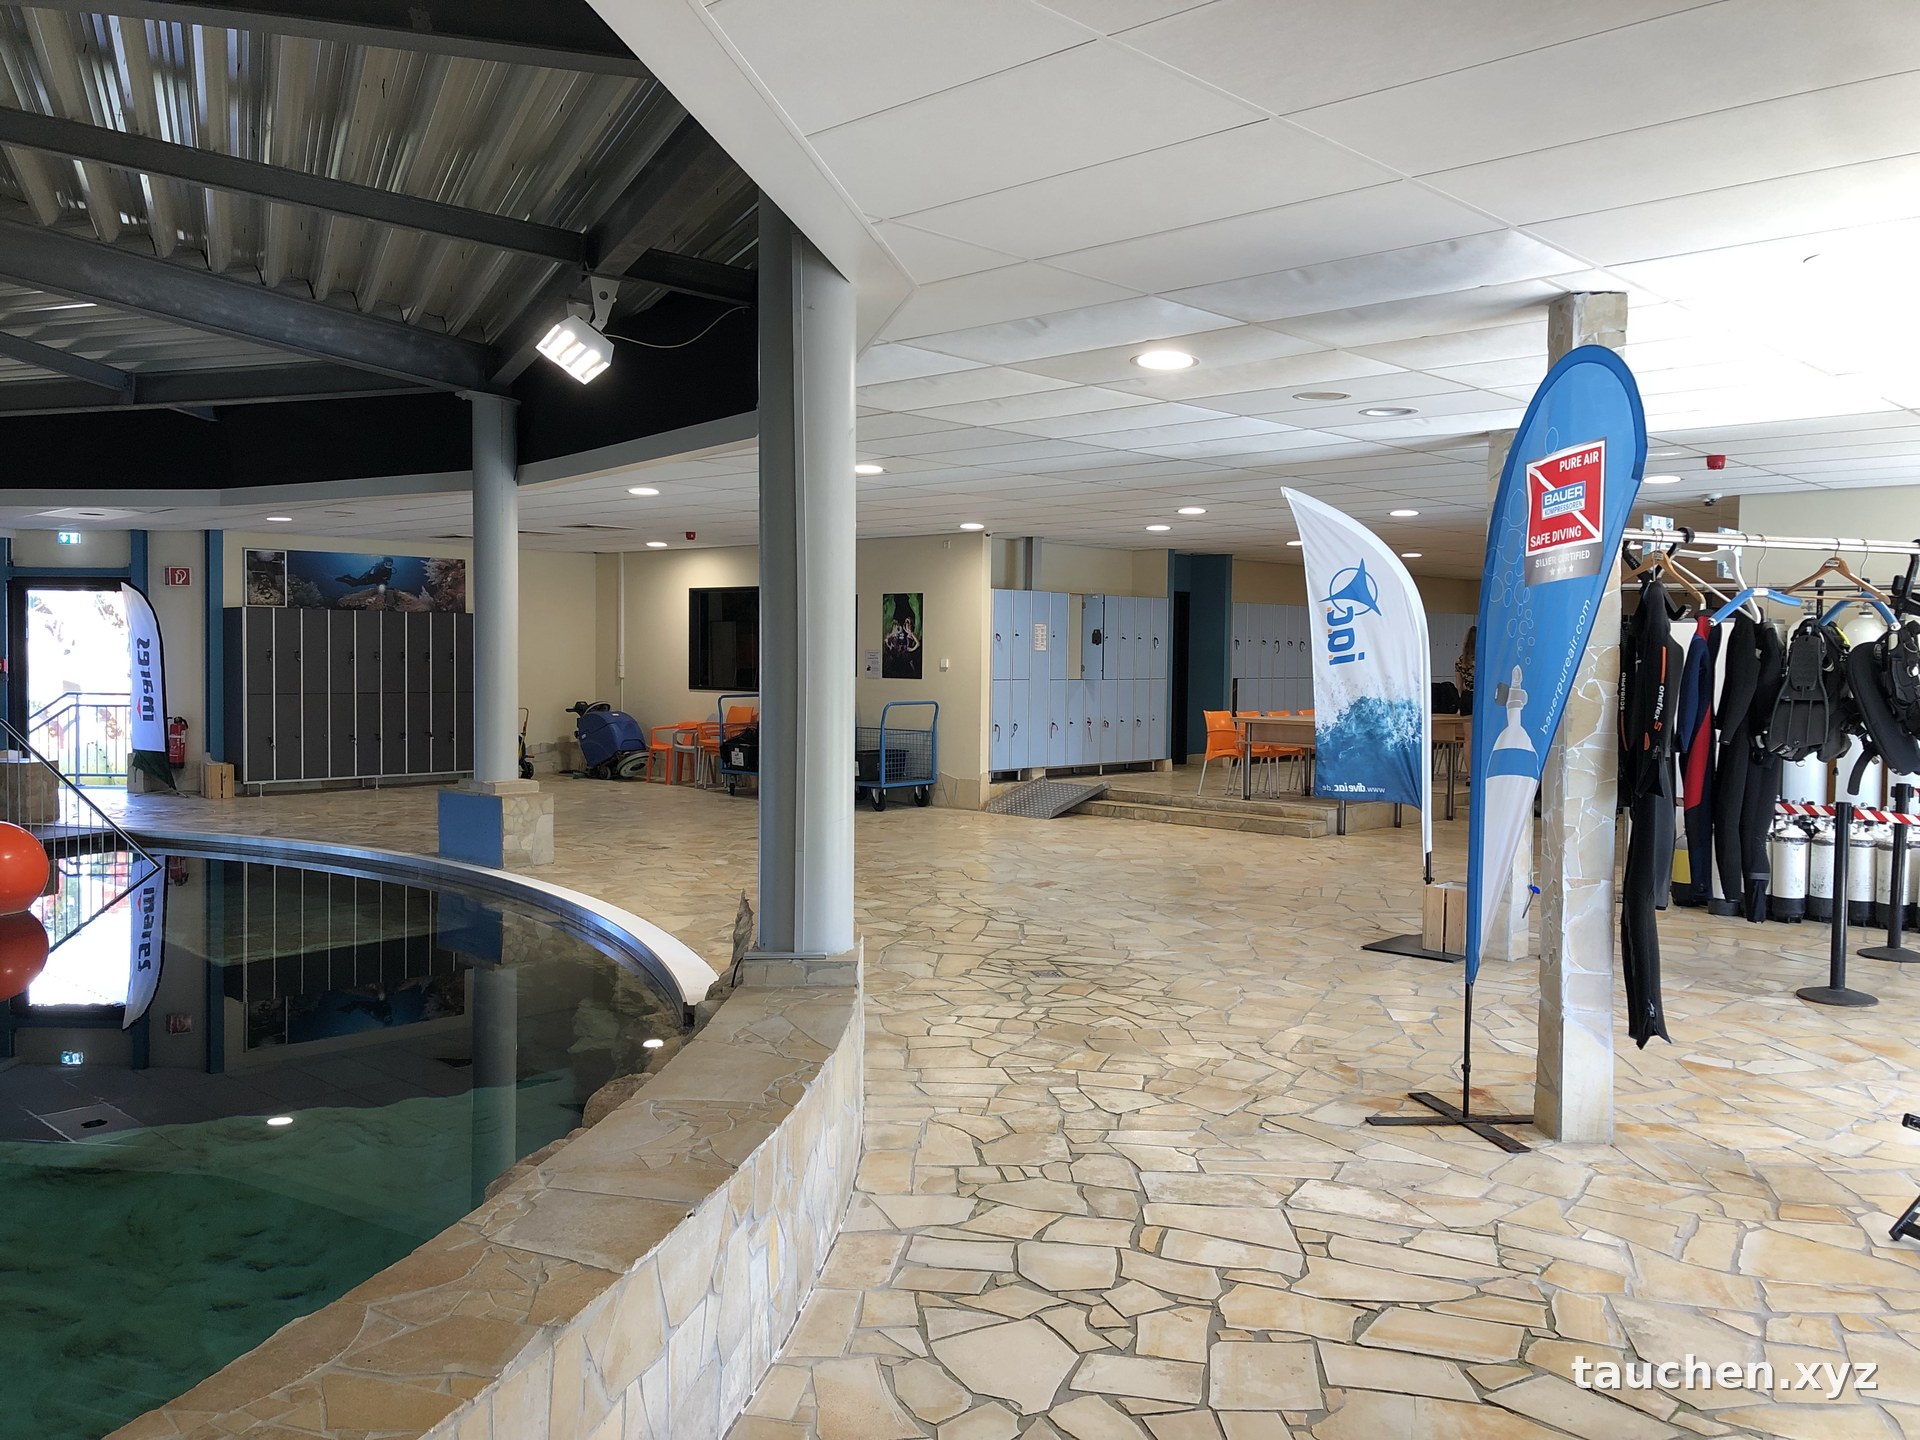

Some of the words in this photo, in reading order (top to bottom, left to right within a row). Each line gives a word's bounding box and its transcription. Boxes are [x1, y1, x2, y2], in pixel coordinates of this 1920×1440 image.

[1559, 455, 1582, 473] PURE
[1584, 451, 1599, 465] AIR
[1544, 486, 1582, 506] BAUER
[1544, 500, 1583, 516] KOMPRESSOREN
[1530, 533, 1551, 548] SAFE
[1552, 525, 1582, 543] DIVING
[1535, 556, 1558, 569] SILVER
[1540, 599, 1590, 736] bauerpureair.com
[1654, 685, 1665, 720] oneflex
